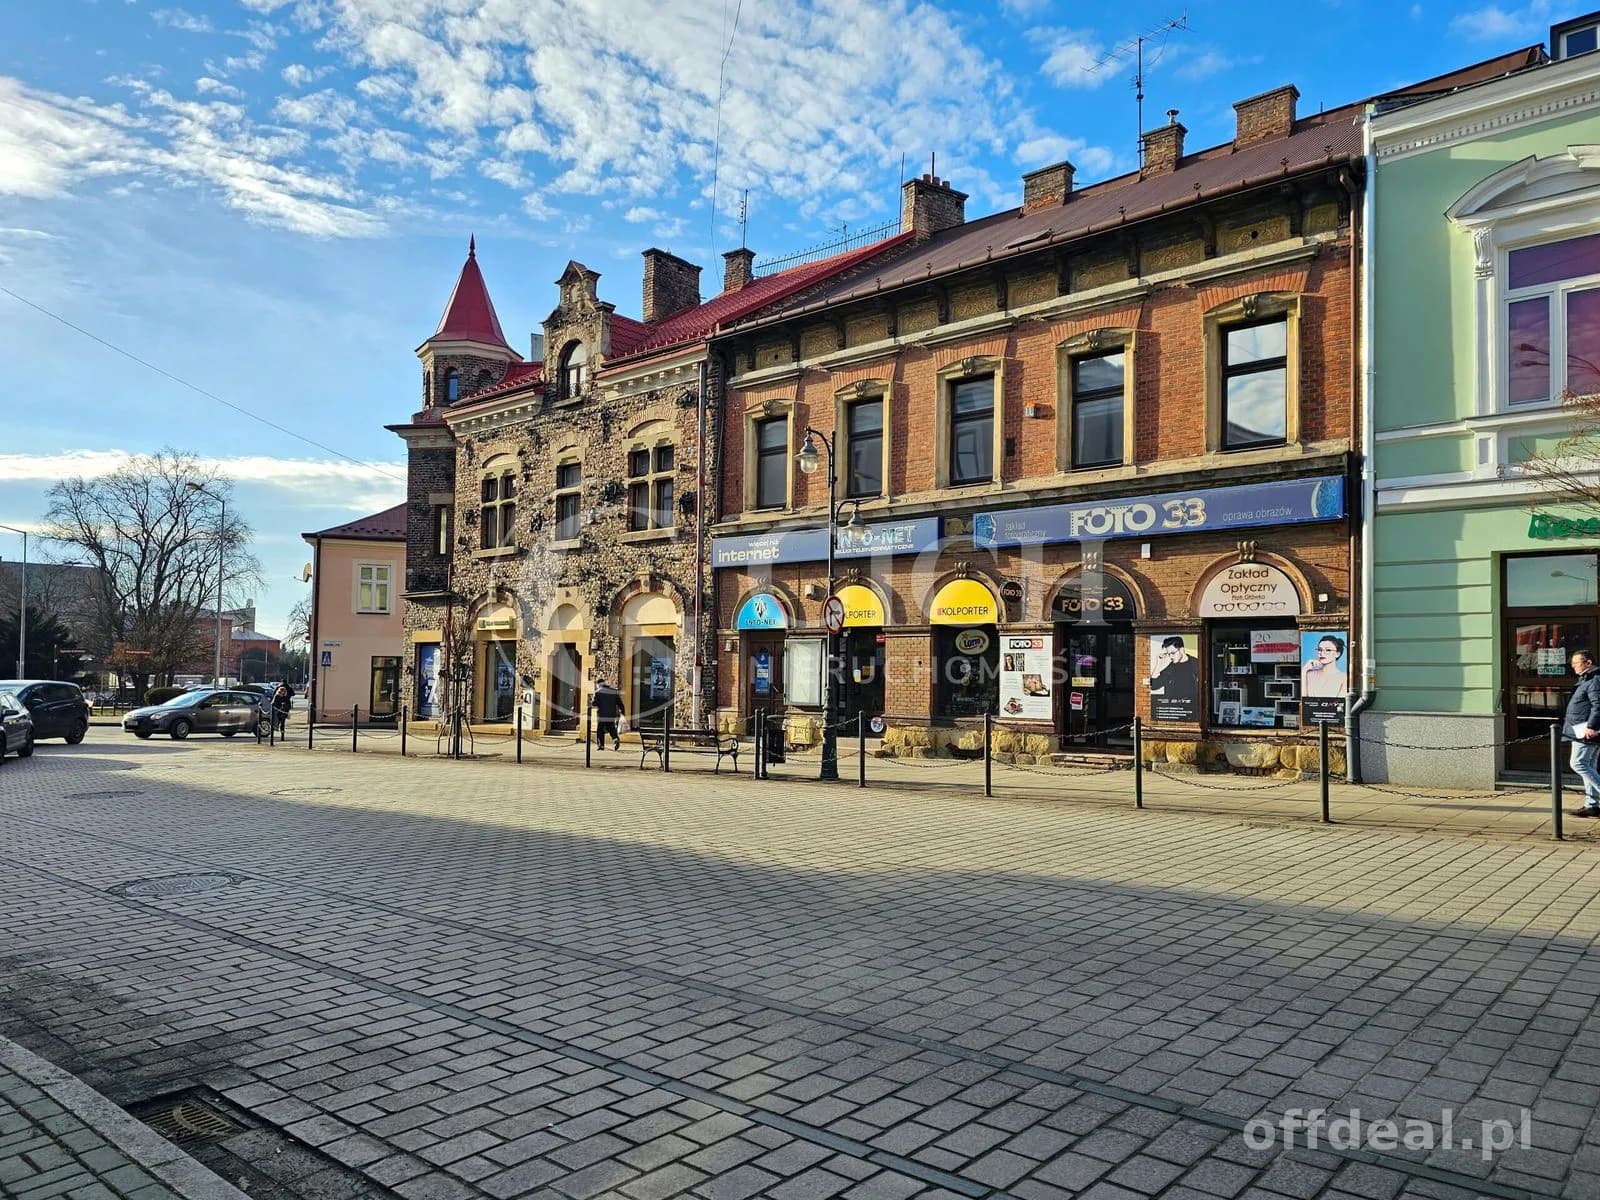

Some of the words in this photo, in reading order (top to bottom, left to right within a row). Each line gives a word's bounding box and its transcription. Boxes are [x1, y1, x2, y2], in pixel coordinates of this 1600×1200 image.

[1069, 503, 1156, 537] FOTO
[1161, 497, 1207, 528] 33
[1222, 511, 1253, 522] oprawa
[718, 547, 779, 563] internet
[1228, 568, 1269, 580] Zakład
[1220, 582, 1278, 595] Optyczny
[1062, 598, 1100, 612] FOTO
[1103, 596, 1124, 611] 33
[844, 610, 877, 619] LPORTER
[942, 606, 989, 616] KOLPORTER
[1010, 640, 1031, 648] FOTO
